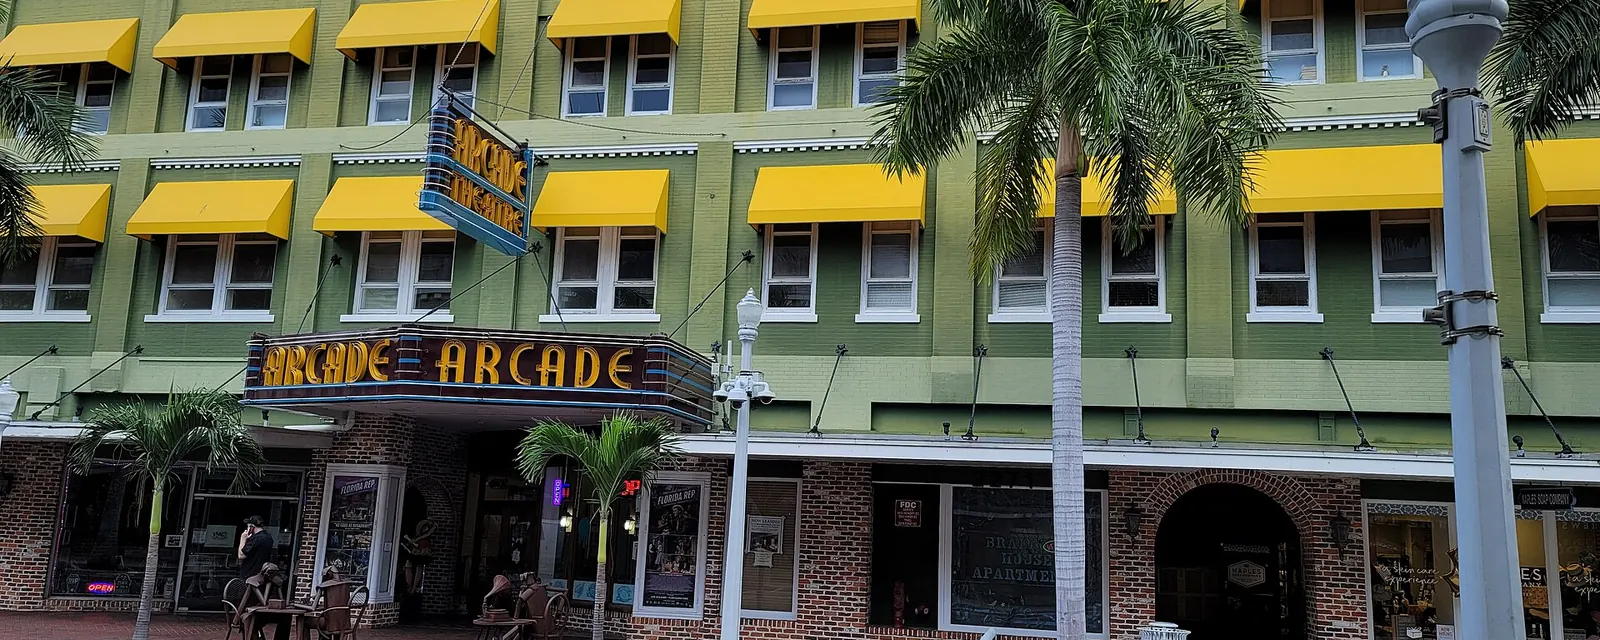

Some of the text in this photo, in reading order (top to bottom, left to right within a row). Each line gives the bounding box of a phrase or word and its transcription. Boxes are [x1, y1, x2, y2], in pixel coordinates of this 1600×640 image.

[454, 119, 527, 203] ARCADE
[450, 170, 523, 237] THEATRE
[262, 338, 391, 387] ARCADE
[435, 339, 633, 389] ARCADE
[340, 479, 375, 495] FLORIDA REP
[657, 489, 696, 506] FLORIDA REP
[900, 501, 917, 509] FDC
[1001, 552, 1053, 567] HOUSE
[971, 566, 1056, 583] APARTME
[1393, 562, 1415, 575] skin
[1416, 567, 1440, 575] care
[1521, 567, 1542, 581] ES
[88, 584, 114, 592] OPEN
[1384, 575, 1440, 590] experience
[1574, 587, 1600, 601] expe
